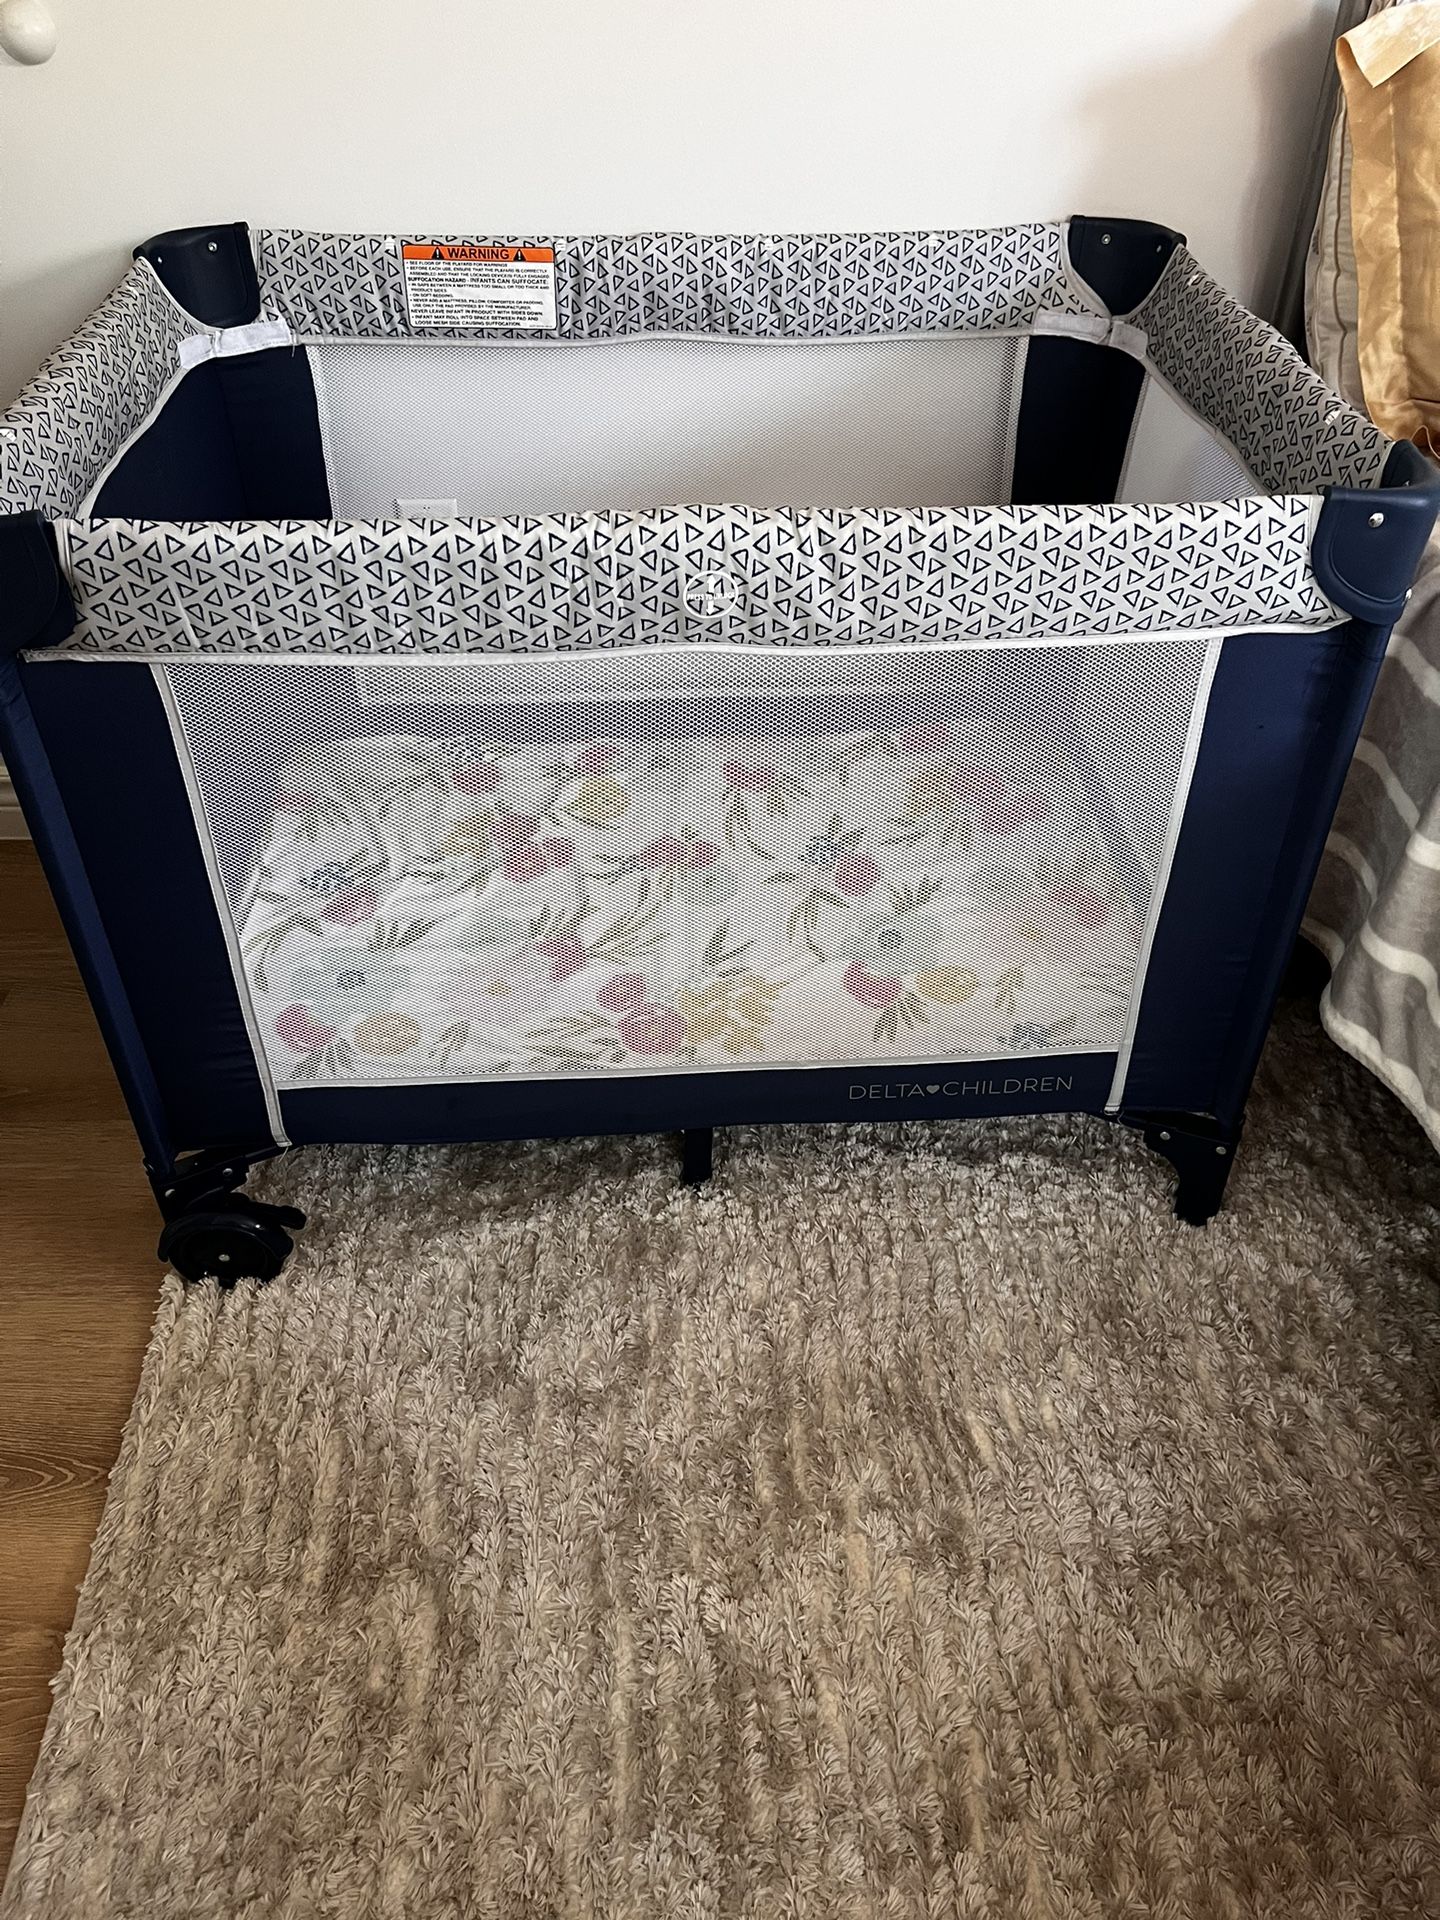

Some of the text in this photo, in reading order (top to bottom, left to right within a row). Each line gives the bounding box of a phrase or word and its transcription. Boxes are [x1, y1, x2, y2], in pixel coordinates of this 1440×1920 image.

[448, 248, 509, 259] WARNING
[849, 1076, 1073, 1100] DELTA CHILDREN
